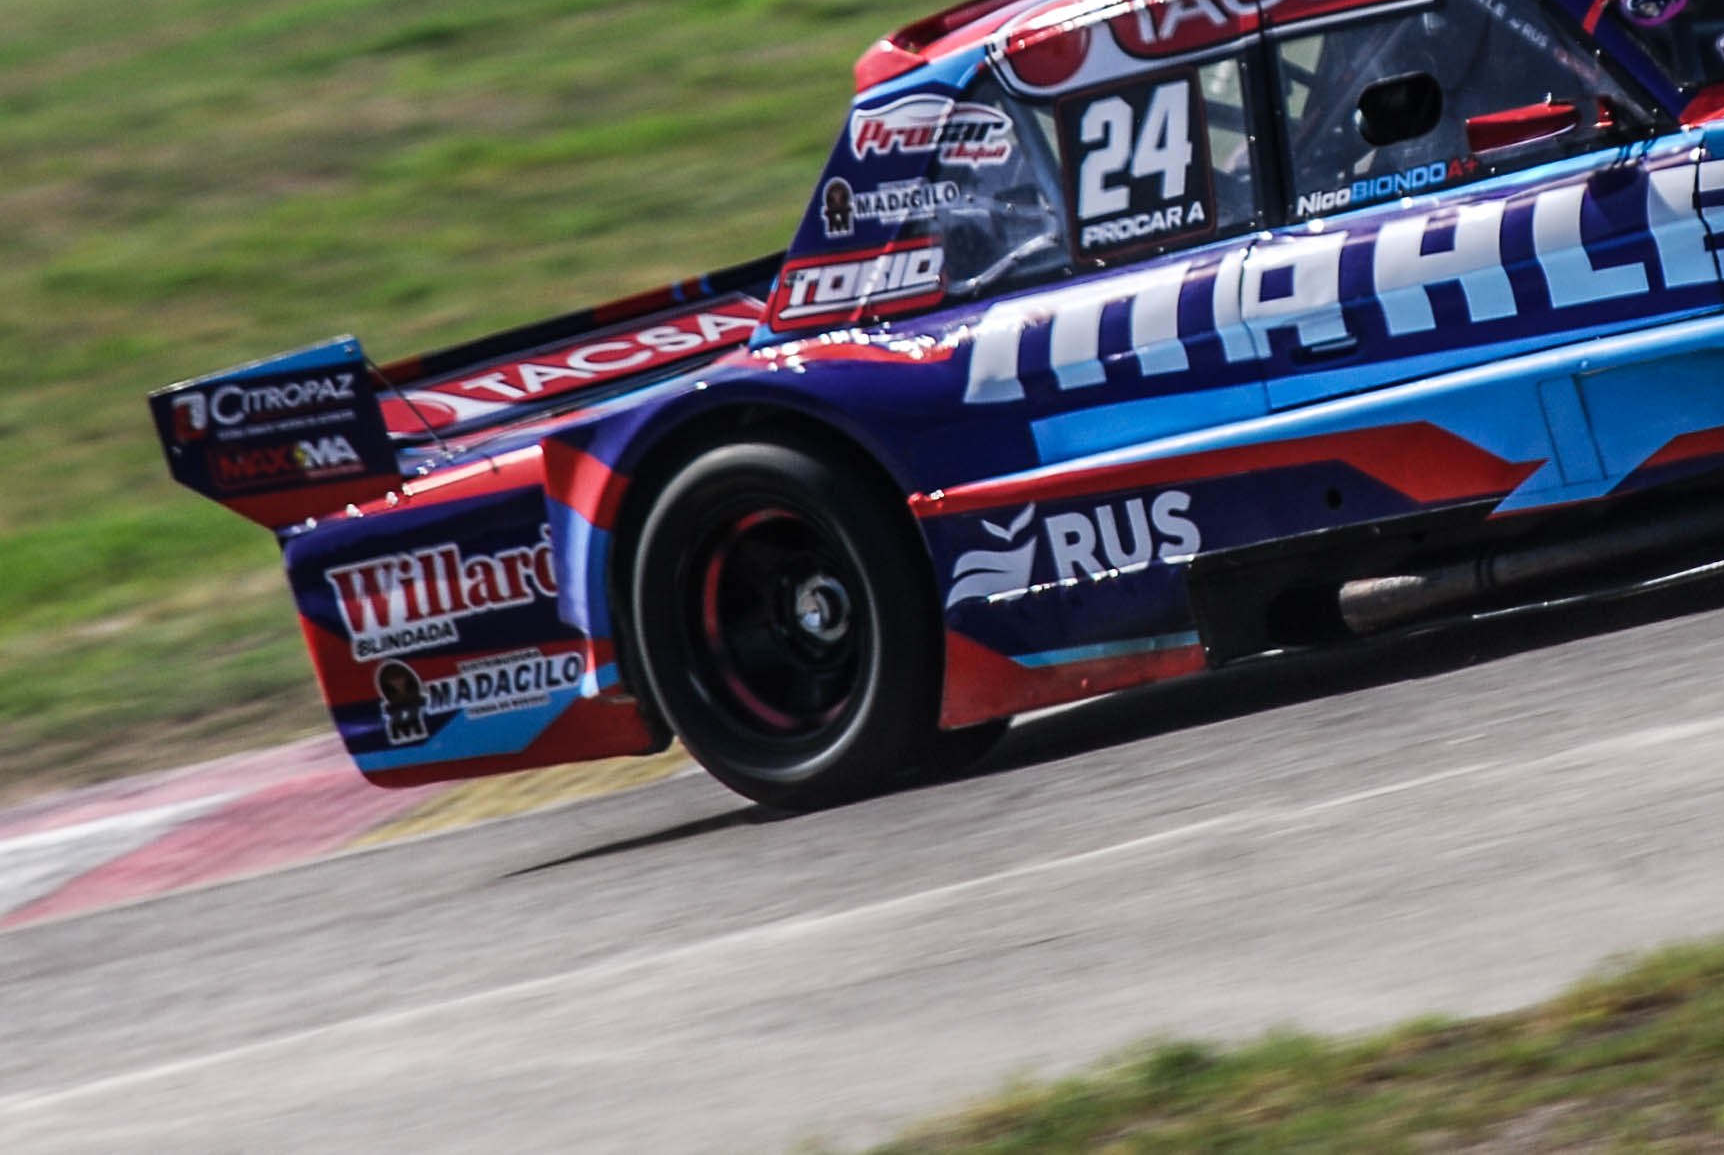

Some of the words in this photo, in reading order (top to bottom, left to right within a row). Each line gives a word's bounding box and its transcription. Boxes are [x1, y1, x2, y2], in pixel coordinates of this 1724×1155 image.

[1078, 79, 1192, 220] 24
[1297, 187, 1351, 216] Nico
[1351, 161, 1446, 201] BIONDO
[1081, 205, 1183, 248] PROCAR
[1187, 200, 1205, 223] A
[461, 312, 759, 397] TACSA
[1044, 490, 1200, 584] RUS
[357, 622, 456, 657] BLINDADA
[429, 654, 582, 708] MADACILO
